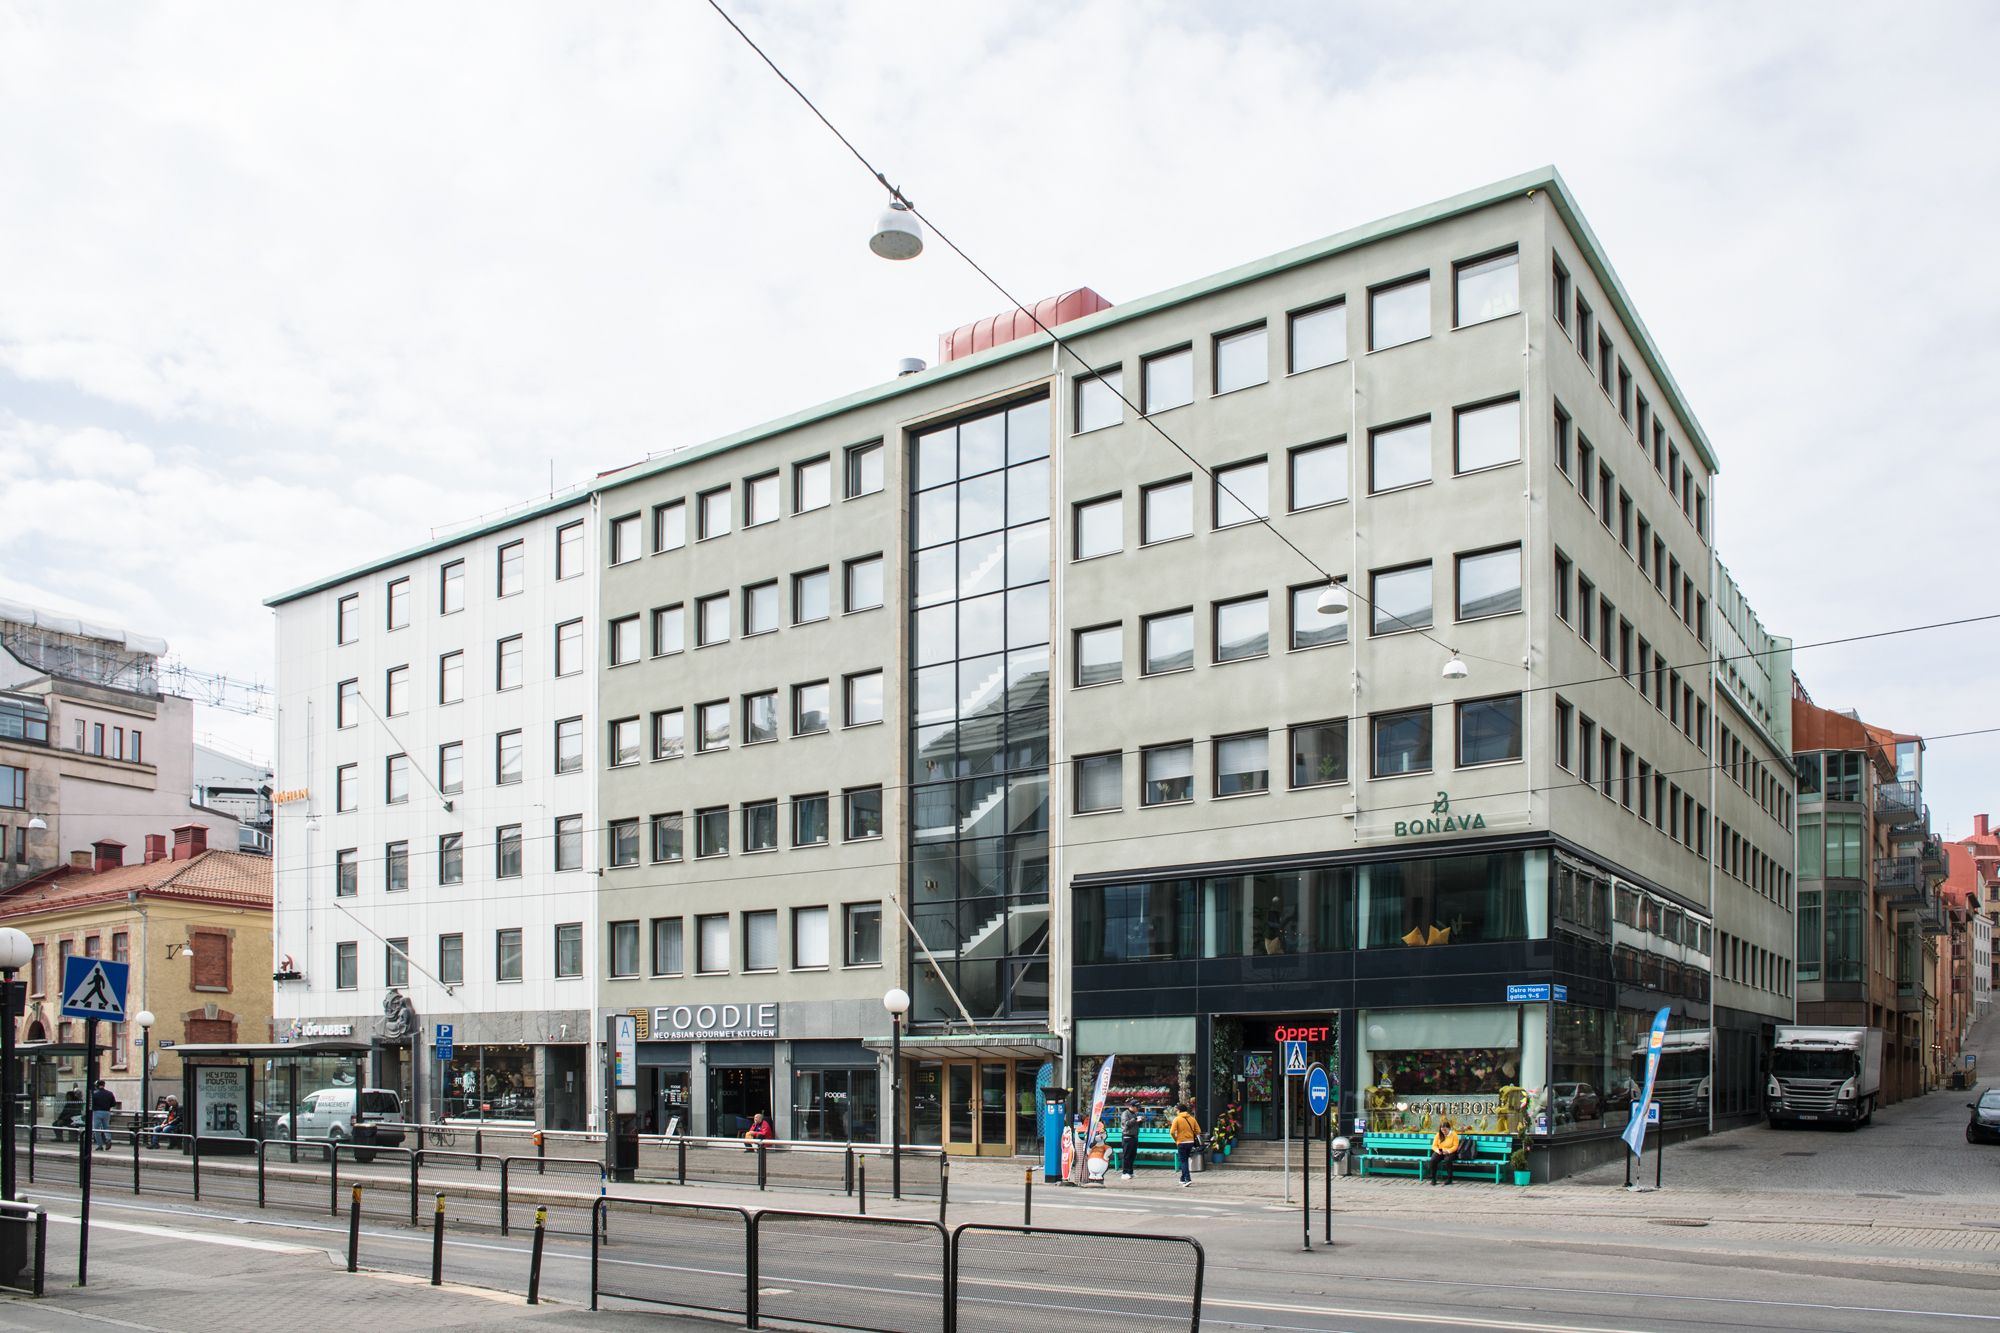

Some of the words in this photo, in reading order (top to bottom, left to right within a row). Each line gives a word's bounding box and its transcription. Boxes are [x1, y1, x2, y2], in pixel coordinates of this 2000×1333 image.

[1394, 813, 1486, 837] BONAVA
[654, 1004, 775, 1030] FOODIE
[302, 1022, 353, 1036] LÖPLABBET
[441, 1025, 450, 1037] P
[560, 1024, 567, 1038] 7
[621, 1020, 630, 1038] A
[653, 1031, 670, 1039] NEO
[671, 1031, 695, 1039] ASIAN
[696, 1030, 736, 1038] GOURMET
[737, 1029, 775, 1038] KITCHEN
[1274, 1025, 1329, 1042] ÖPPET
[220, 1071, 238, 1079] FOOD
